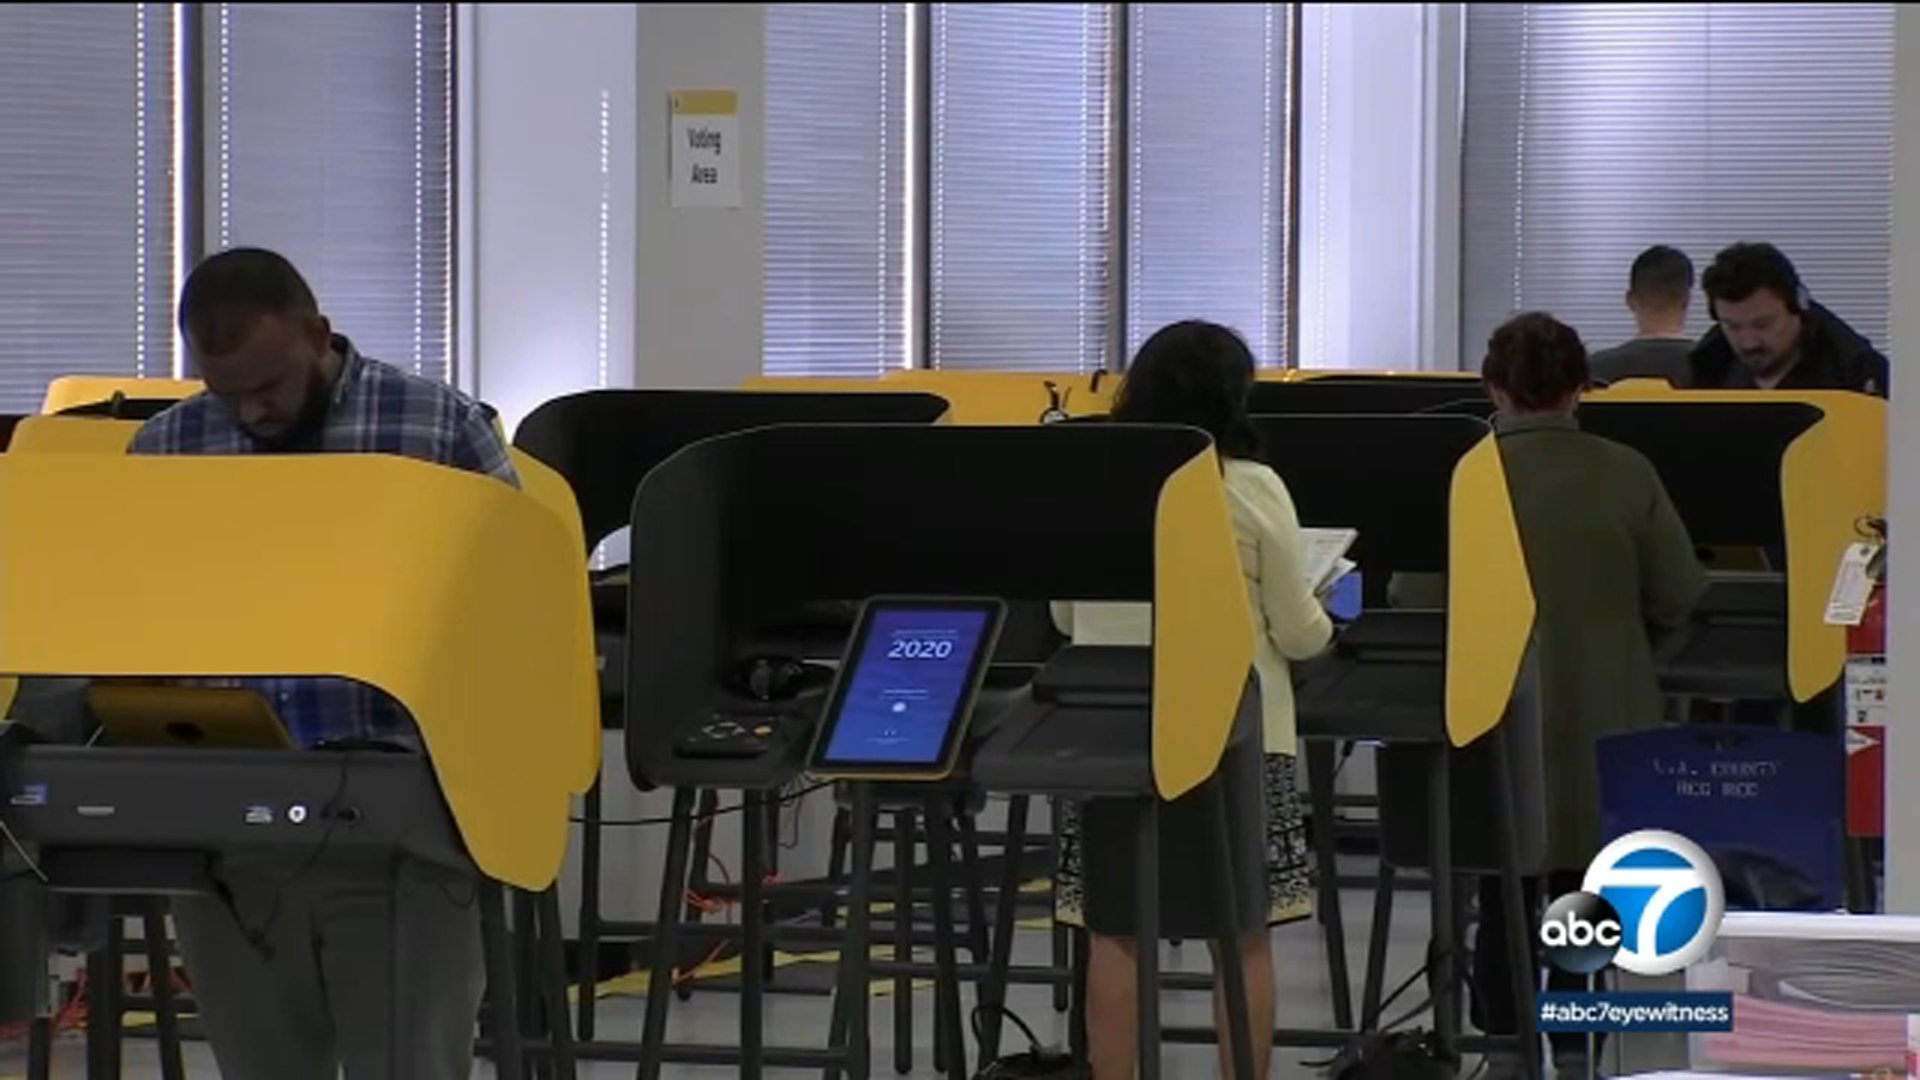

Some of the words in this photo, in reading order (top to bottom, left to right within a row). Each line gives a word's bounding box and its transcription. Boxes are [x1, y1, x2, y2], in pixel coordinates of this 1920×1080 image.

[687, 127, 721, 155] Voting
[691, 163, 717, 184] Area
[888, 640, 952, 659] 2020
